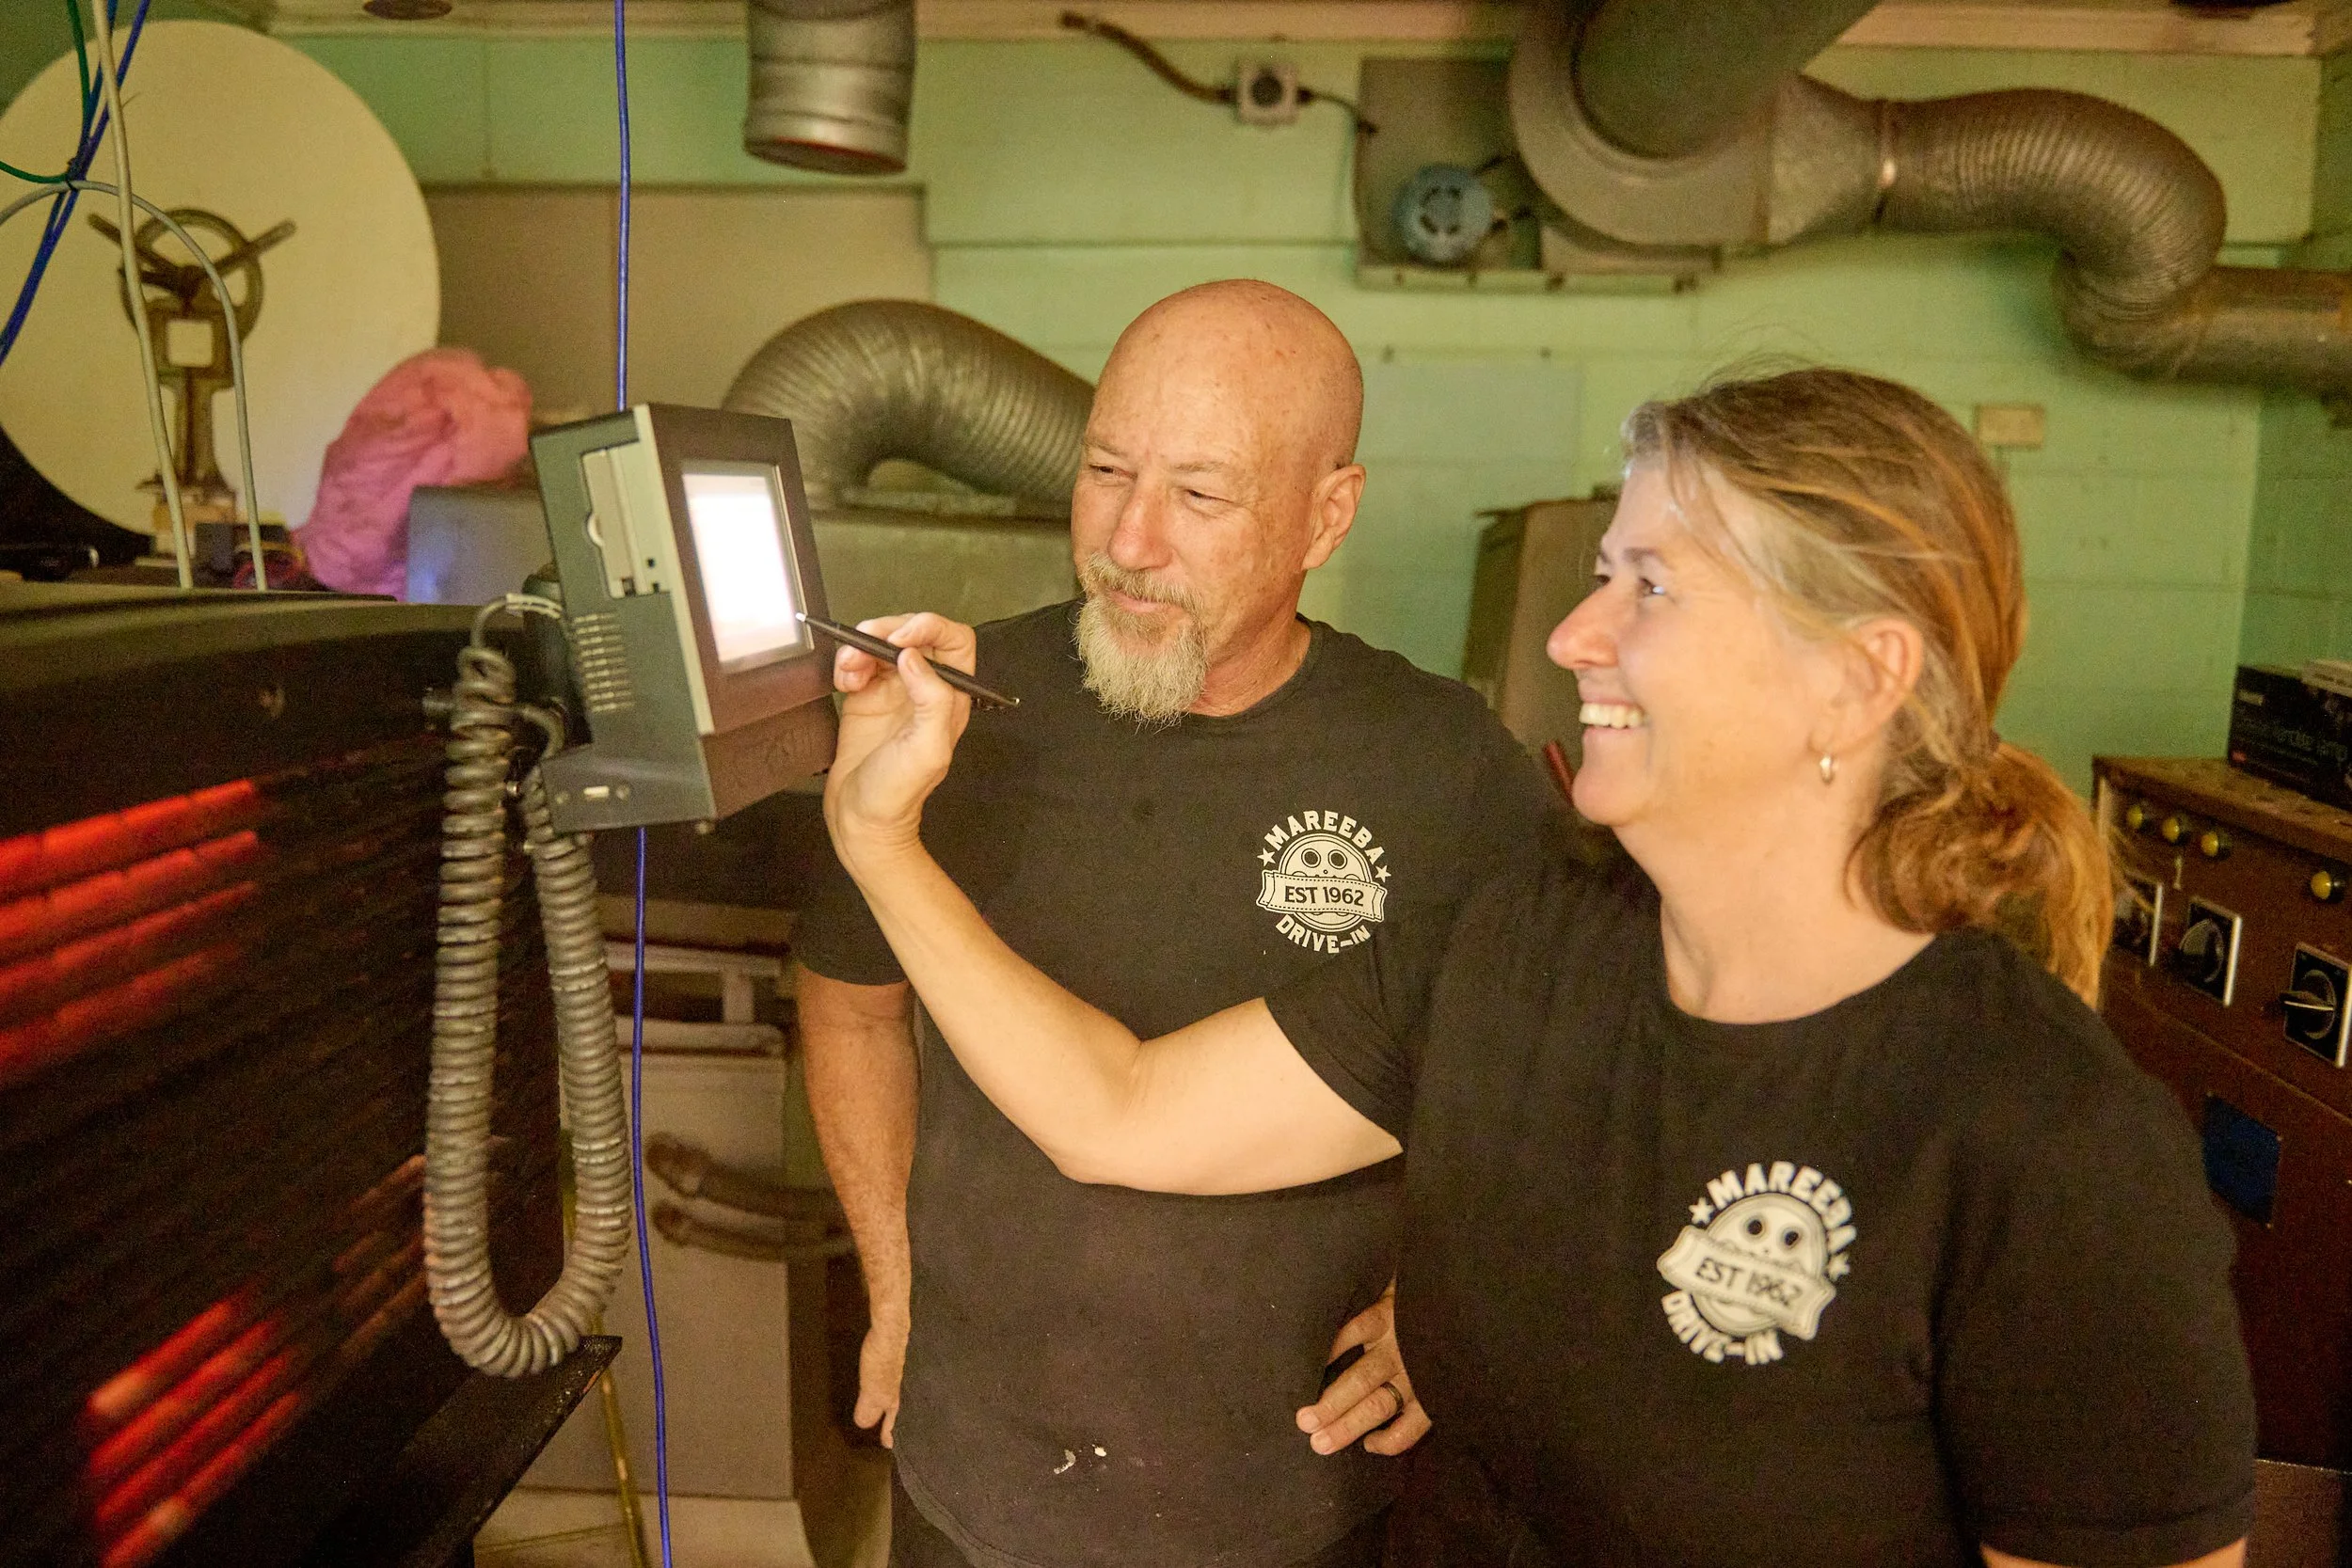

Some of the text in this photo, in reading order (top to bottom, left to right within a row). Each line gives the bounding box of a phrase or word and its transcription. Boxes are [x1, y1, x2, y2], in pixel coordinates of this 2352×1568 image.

[1264, 810, 1385, 864] MAREEBA
[1284, 885, 1364, 907] EST 1962
[1276, 914, 1371, 954] DRIVE-IN
[1695, 1258, 1745, 1287] EST
